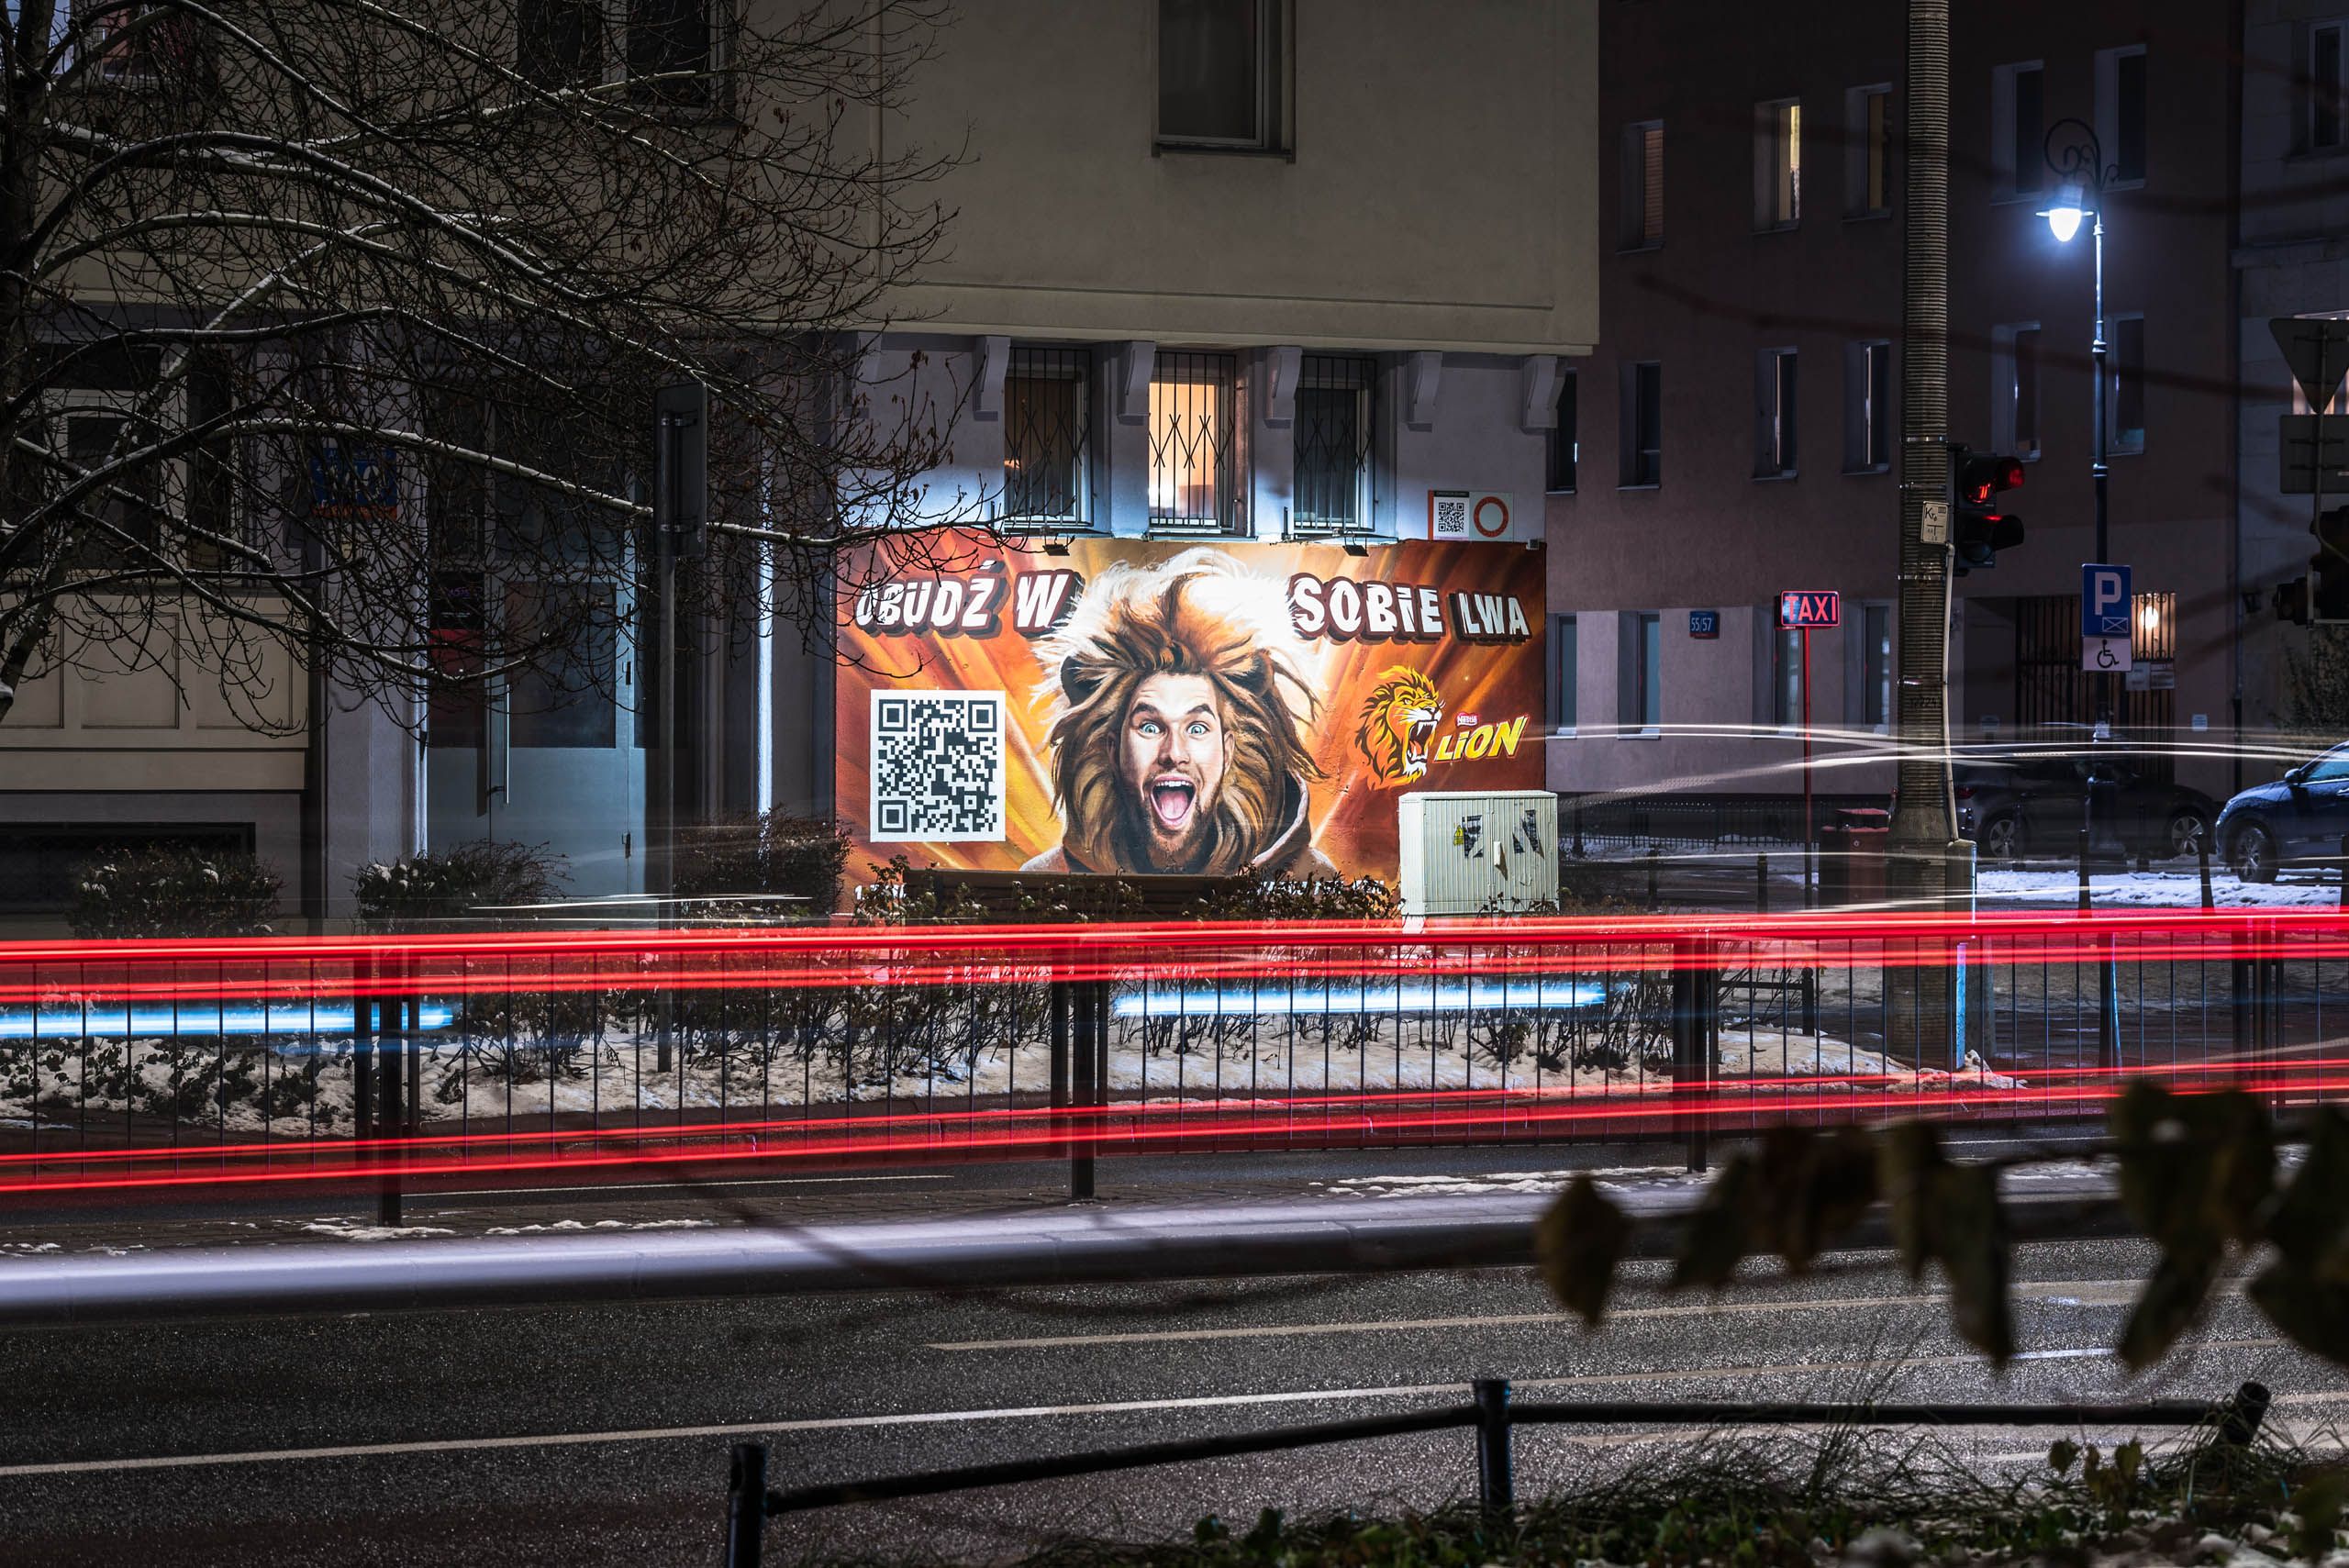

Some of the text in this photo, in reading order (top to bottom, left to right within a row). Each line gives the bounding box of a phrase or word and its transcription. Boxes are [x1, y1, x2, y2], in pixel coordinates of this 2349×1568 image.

[855, 560, 996, 628] OBUDŹ
[1017, 573, 1070, 628] W
[1459, 593, 1529, 636] LWA
[1785, 596, 1836, 621] TAXI
[2095, 572, 2121, 616] P
[1691, 617, 1712, 632] 55/57
